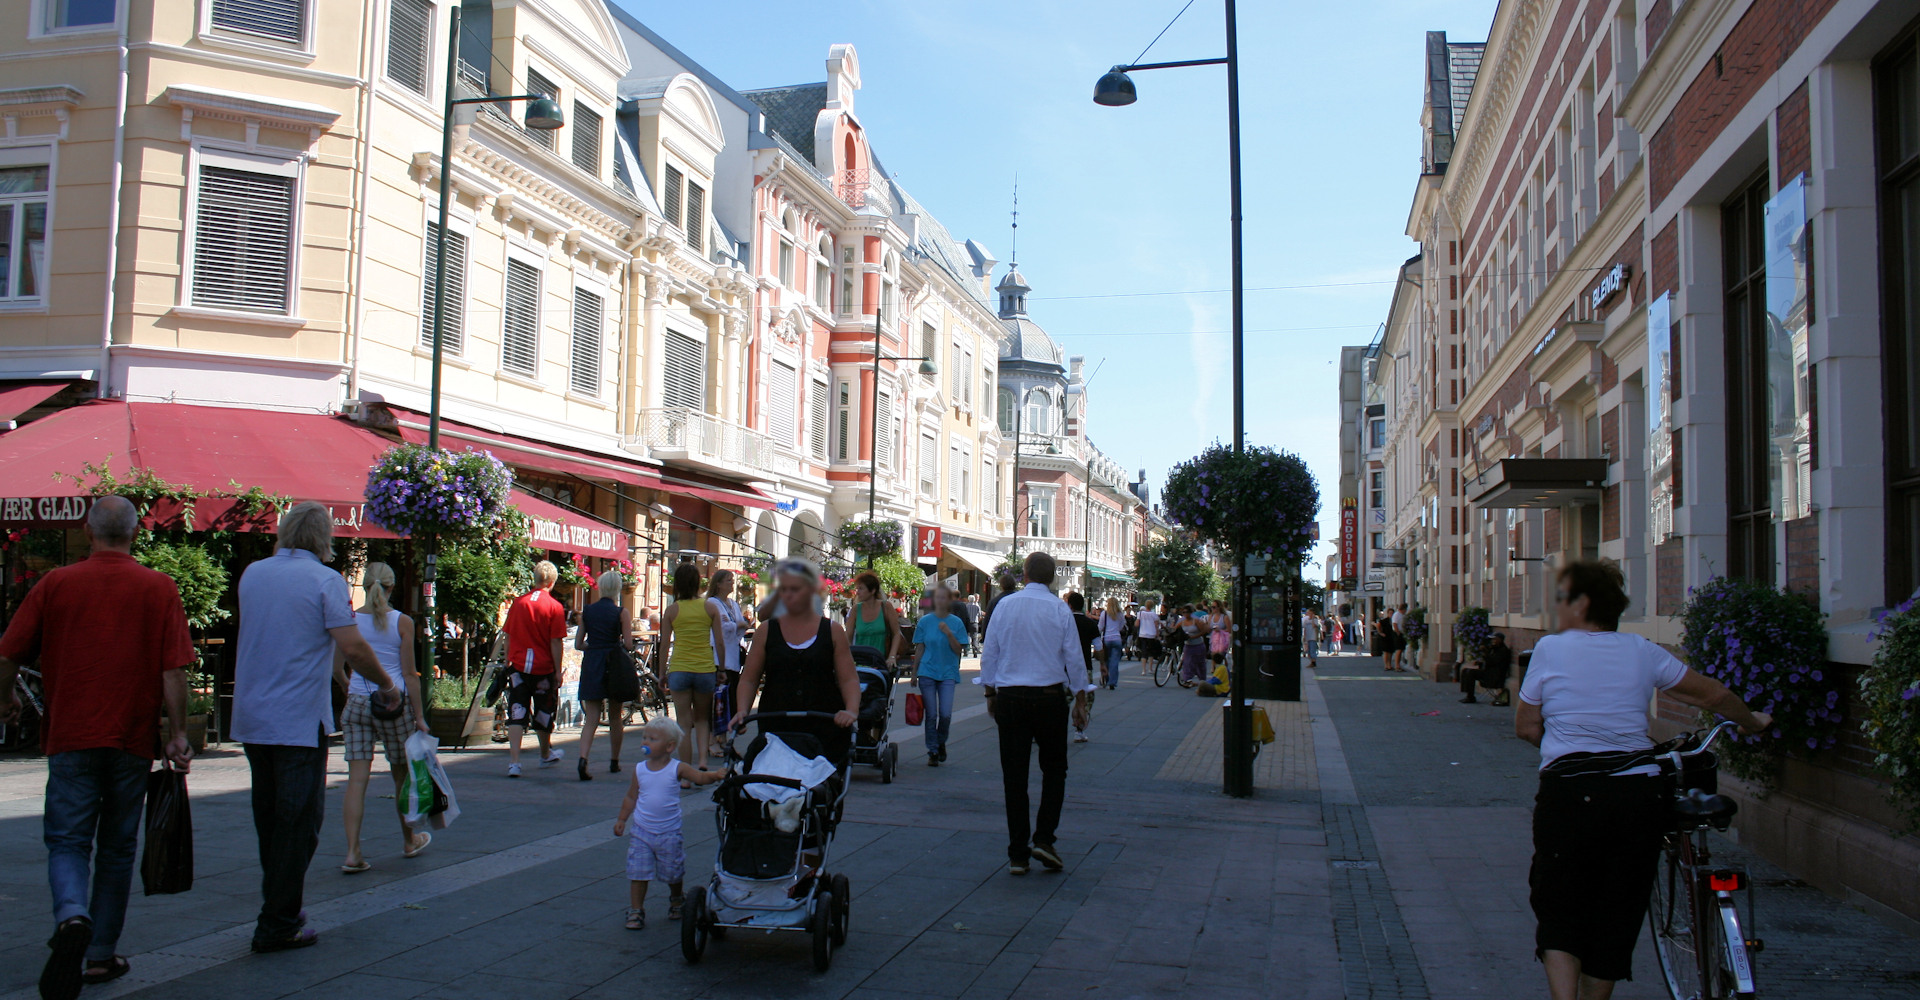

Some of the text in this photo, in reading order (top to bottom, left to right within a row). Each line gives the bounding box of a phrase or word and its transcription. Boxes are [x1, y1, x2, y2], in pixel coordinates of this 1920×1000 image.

[38, 496, 86, 521] GLAD
[534, 519, 561, 543] DRIKK
[563, 524, 570, 544] &
[570, 525, 590, 547] VÆR
[591, 530, 612, 551] GLAD
[1344, 510, 1355, 576] McDonald's
[1055, 566, 1076, 577] ens
[1736, 949, 1745, 970] DBS
